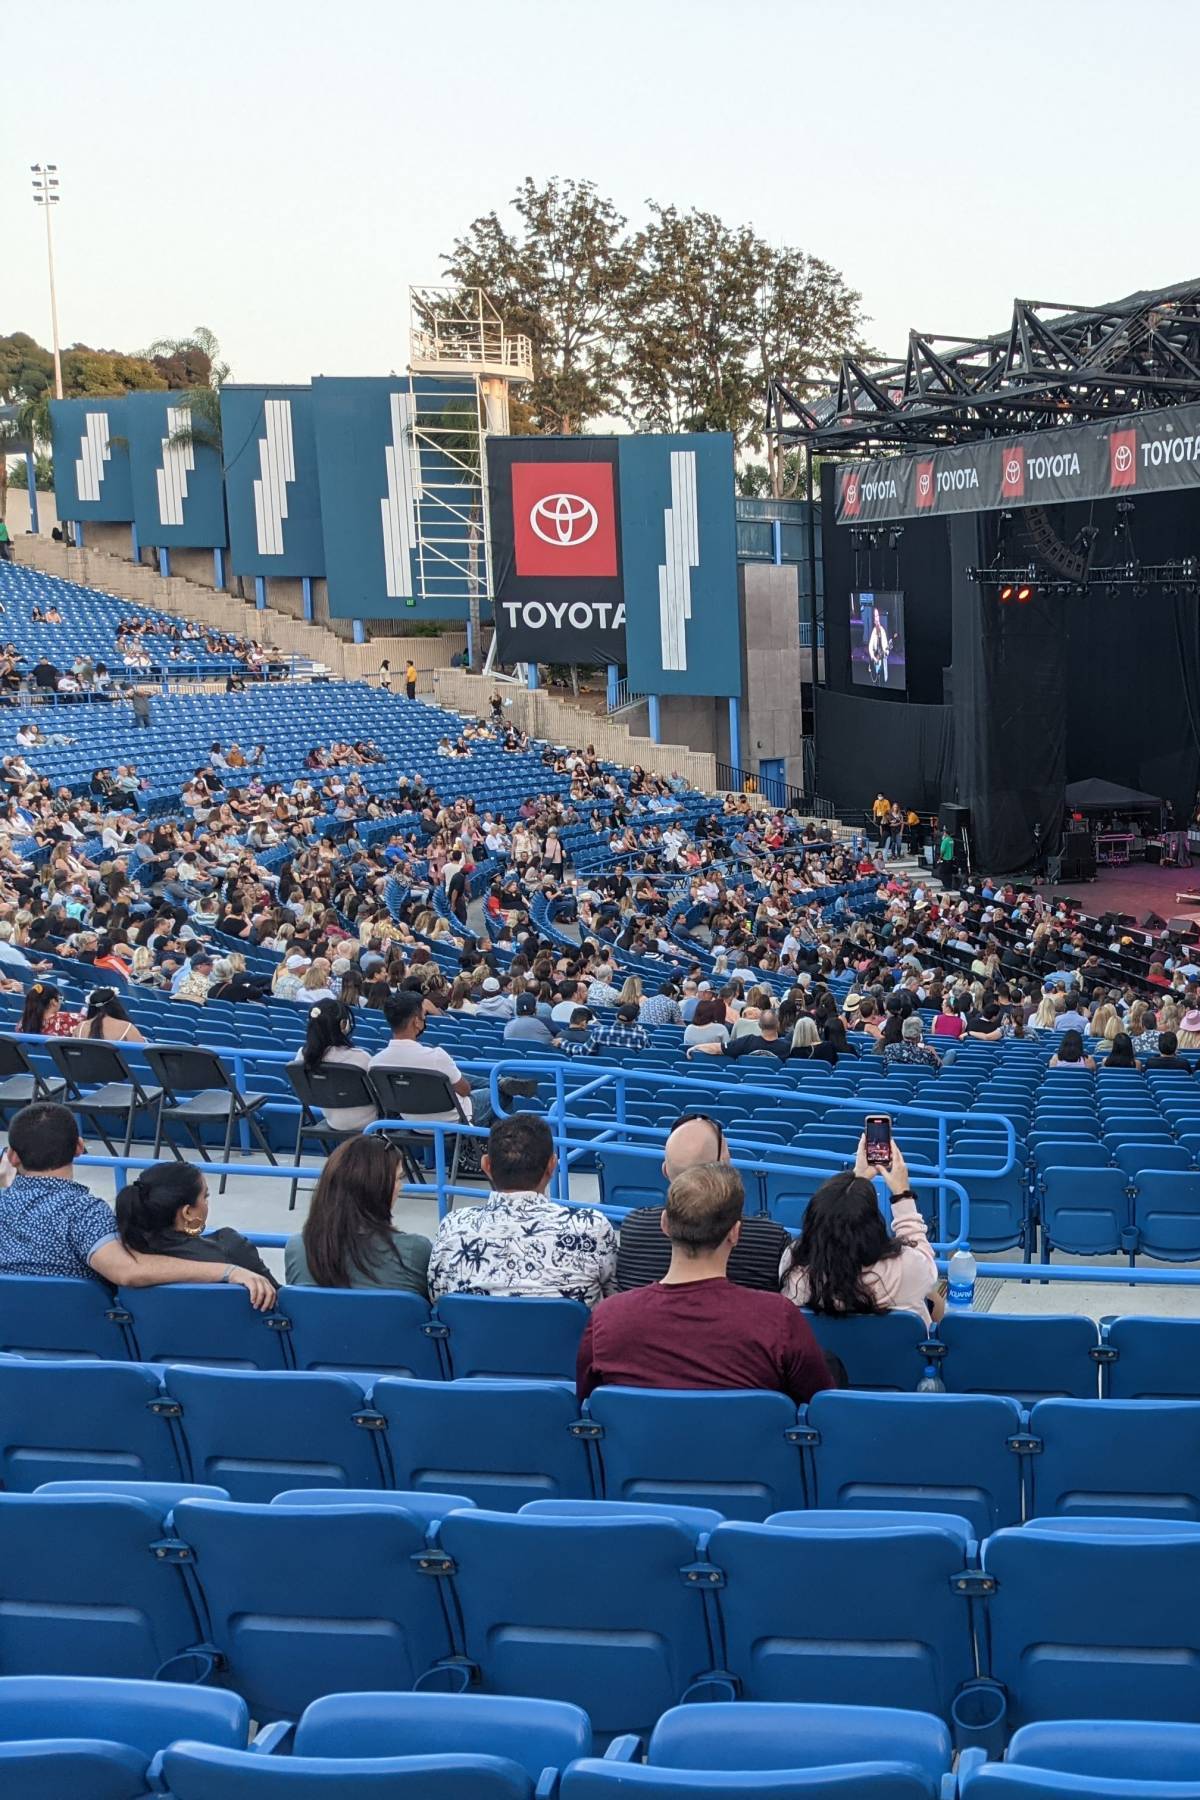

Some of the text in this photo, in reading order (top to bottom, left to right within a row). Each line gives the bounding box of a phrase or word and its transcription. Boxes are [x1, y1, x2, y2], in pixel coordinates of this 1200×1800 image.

[861, 480, 897, 501] TOYOTA
[936, 468, 979, 492] TOYOTA
[1027, 453, 1081, 480] TOYOTA
